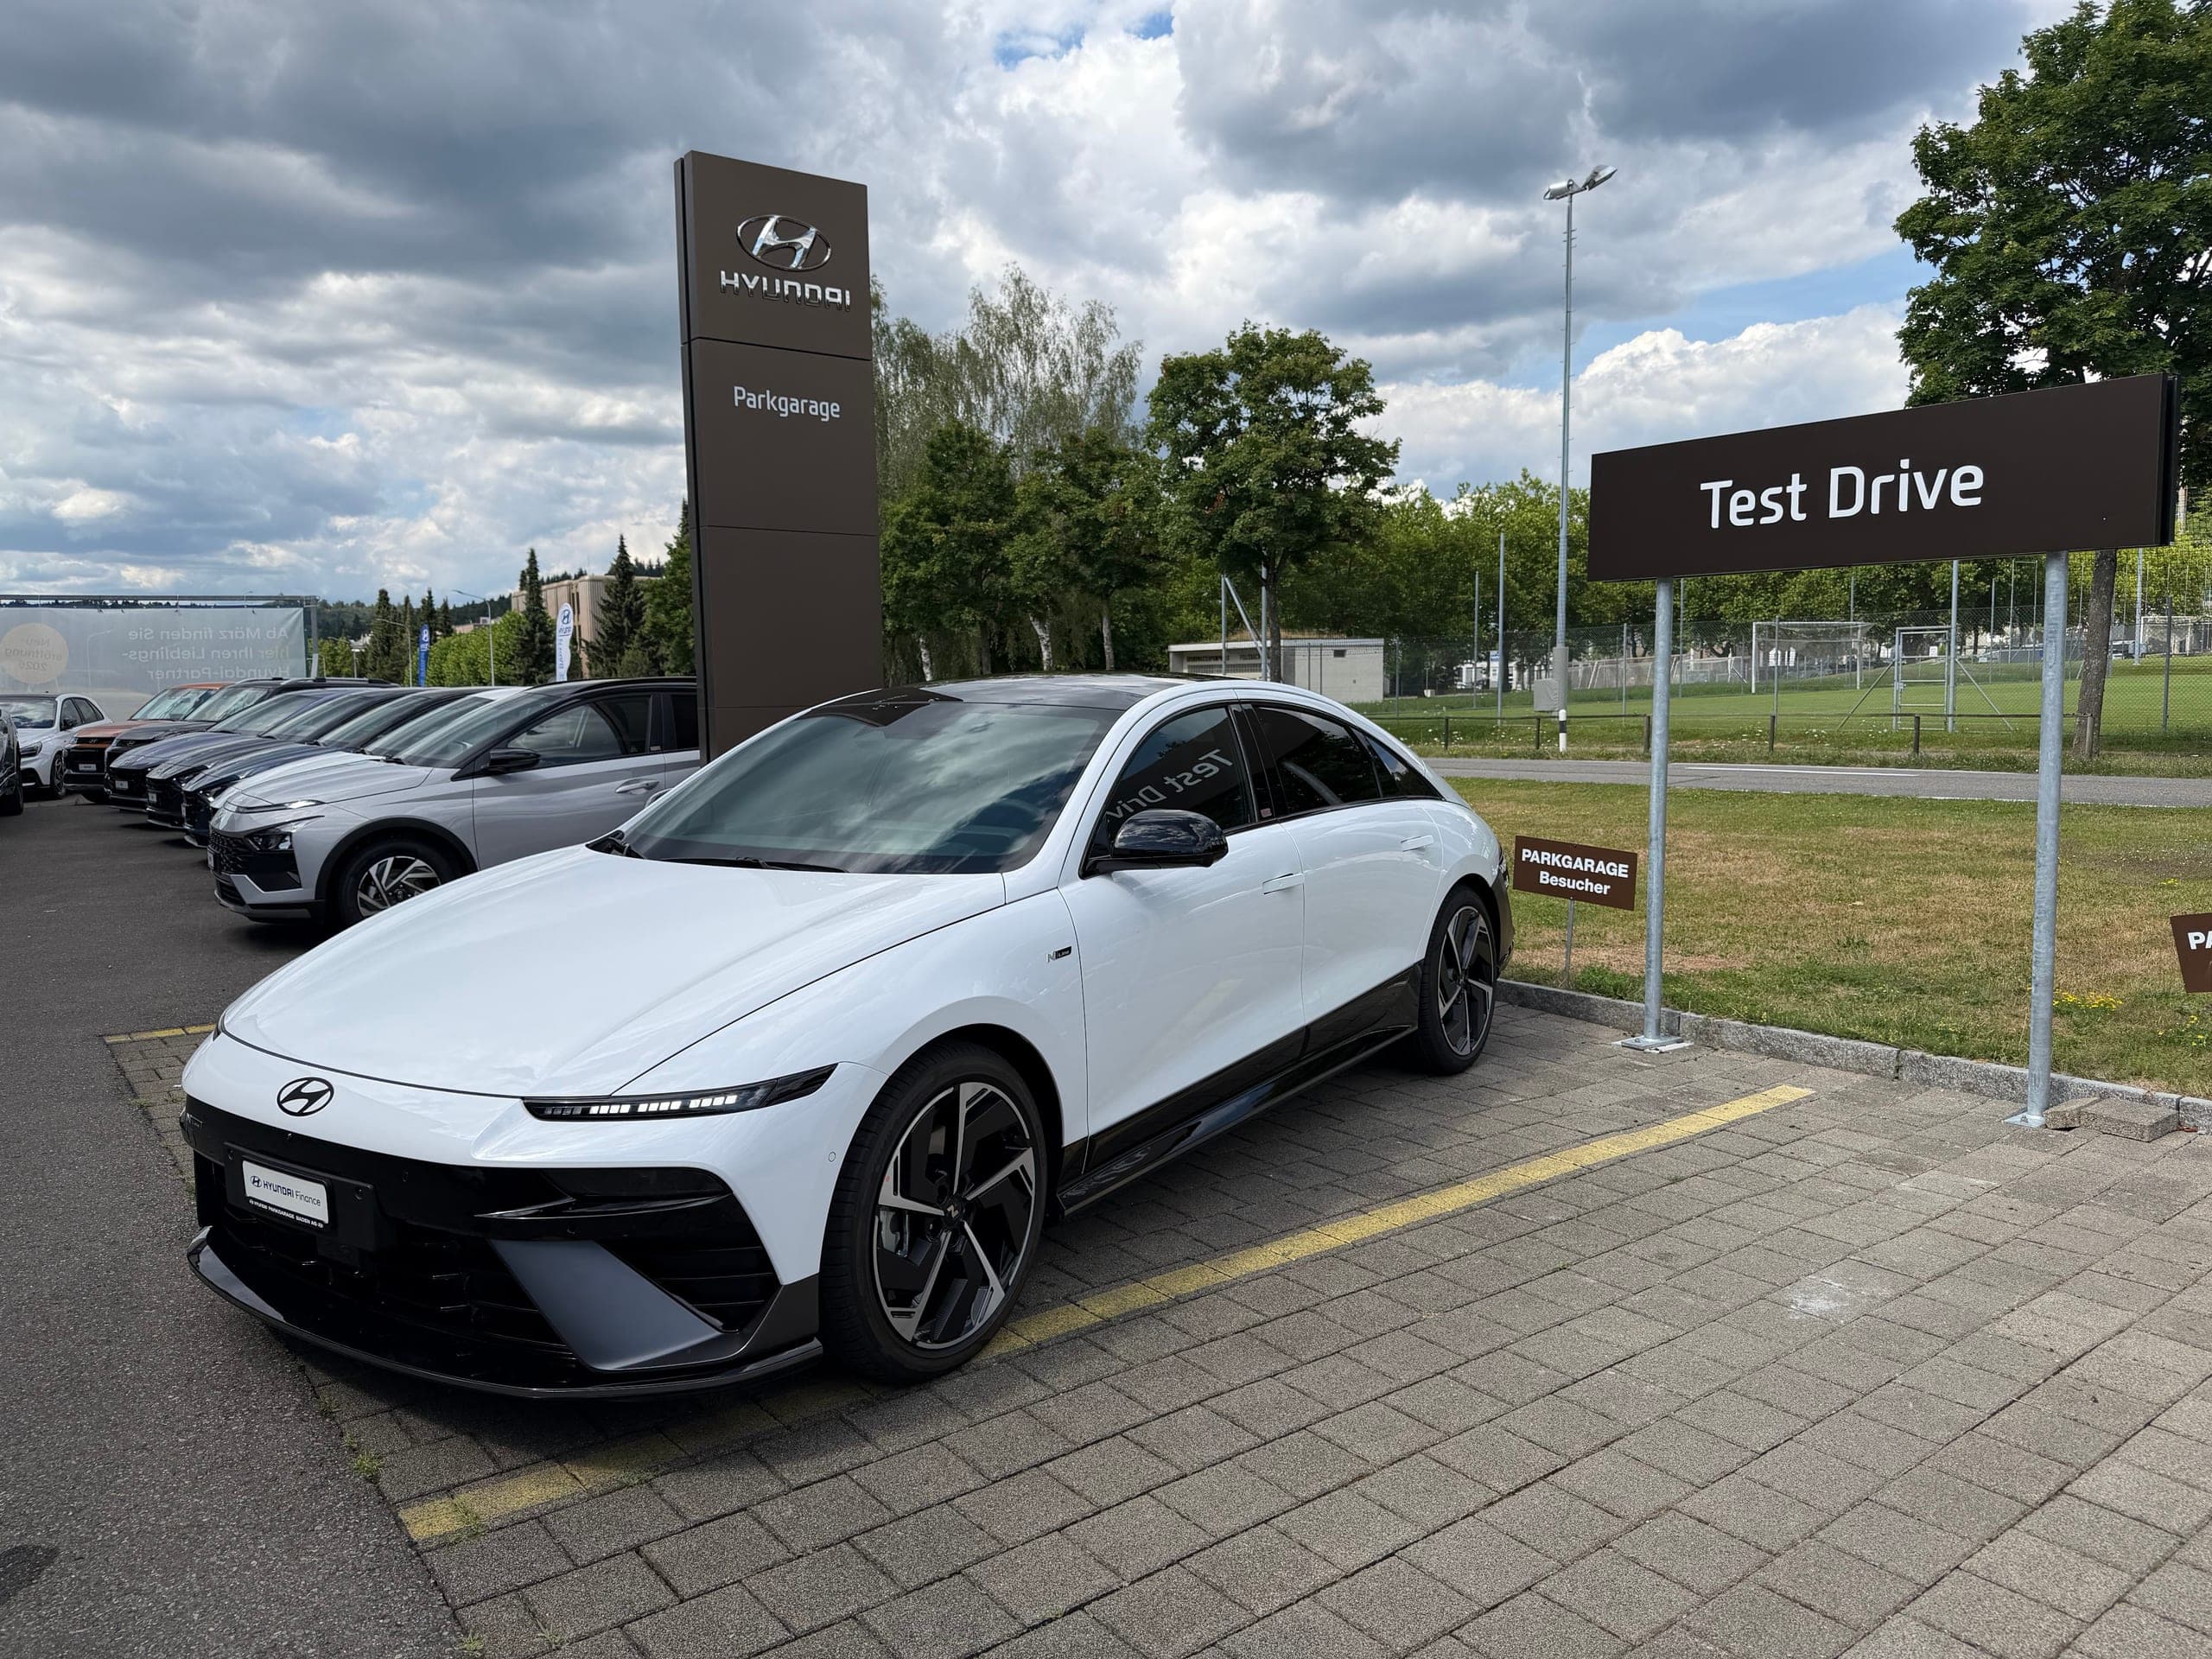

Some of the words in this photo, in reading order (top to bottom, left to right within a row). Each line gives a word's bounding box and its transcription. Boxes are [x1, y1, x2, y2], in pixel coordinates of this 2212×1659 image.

[720, 270, 851, 311] HYUNDAI
[734, 385, 841, 422] Parkgarage
[1700, 473, 1808, 529] Test
[1828, 458, 1984, 518] Drive
[1521, 849, 1629, 879] PARKGARAGE
[1539, 870, 1611, 895] Besucher
[263, 1179, 295, 1198] HYUNDAI
[295, 1190, 321, 1206] Finance
